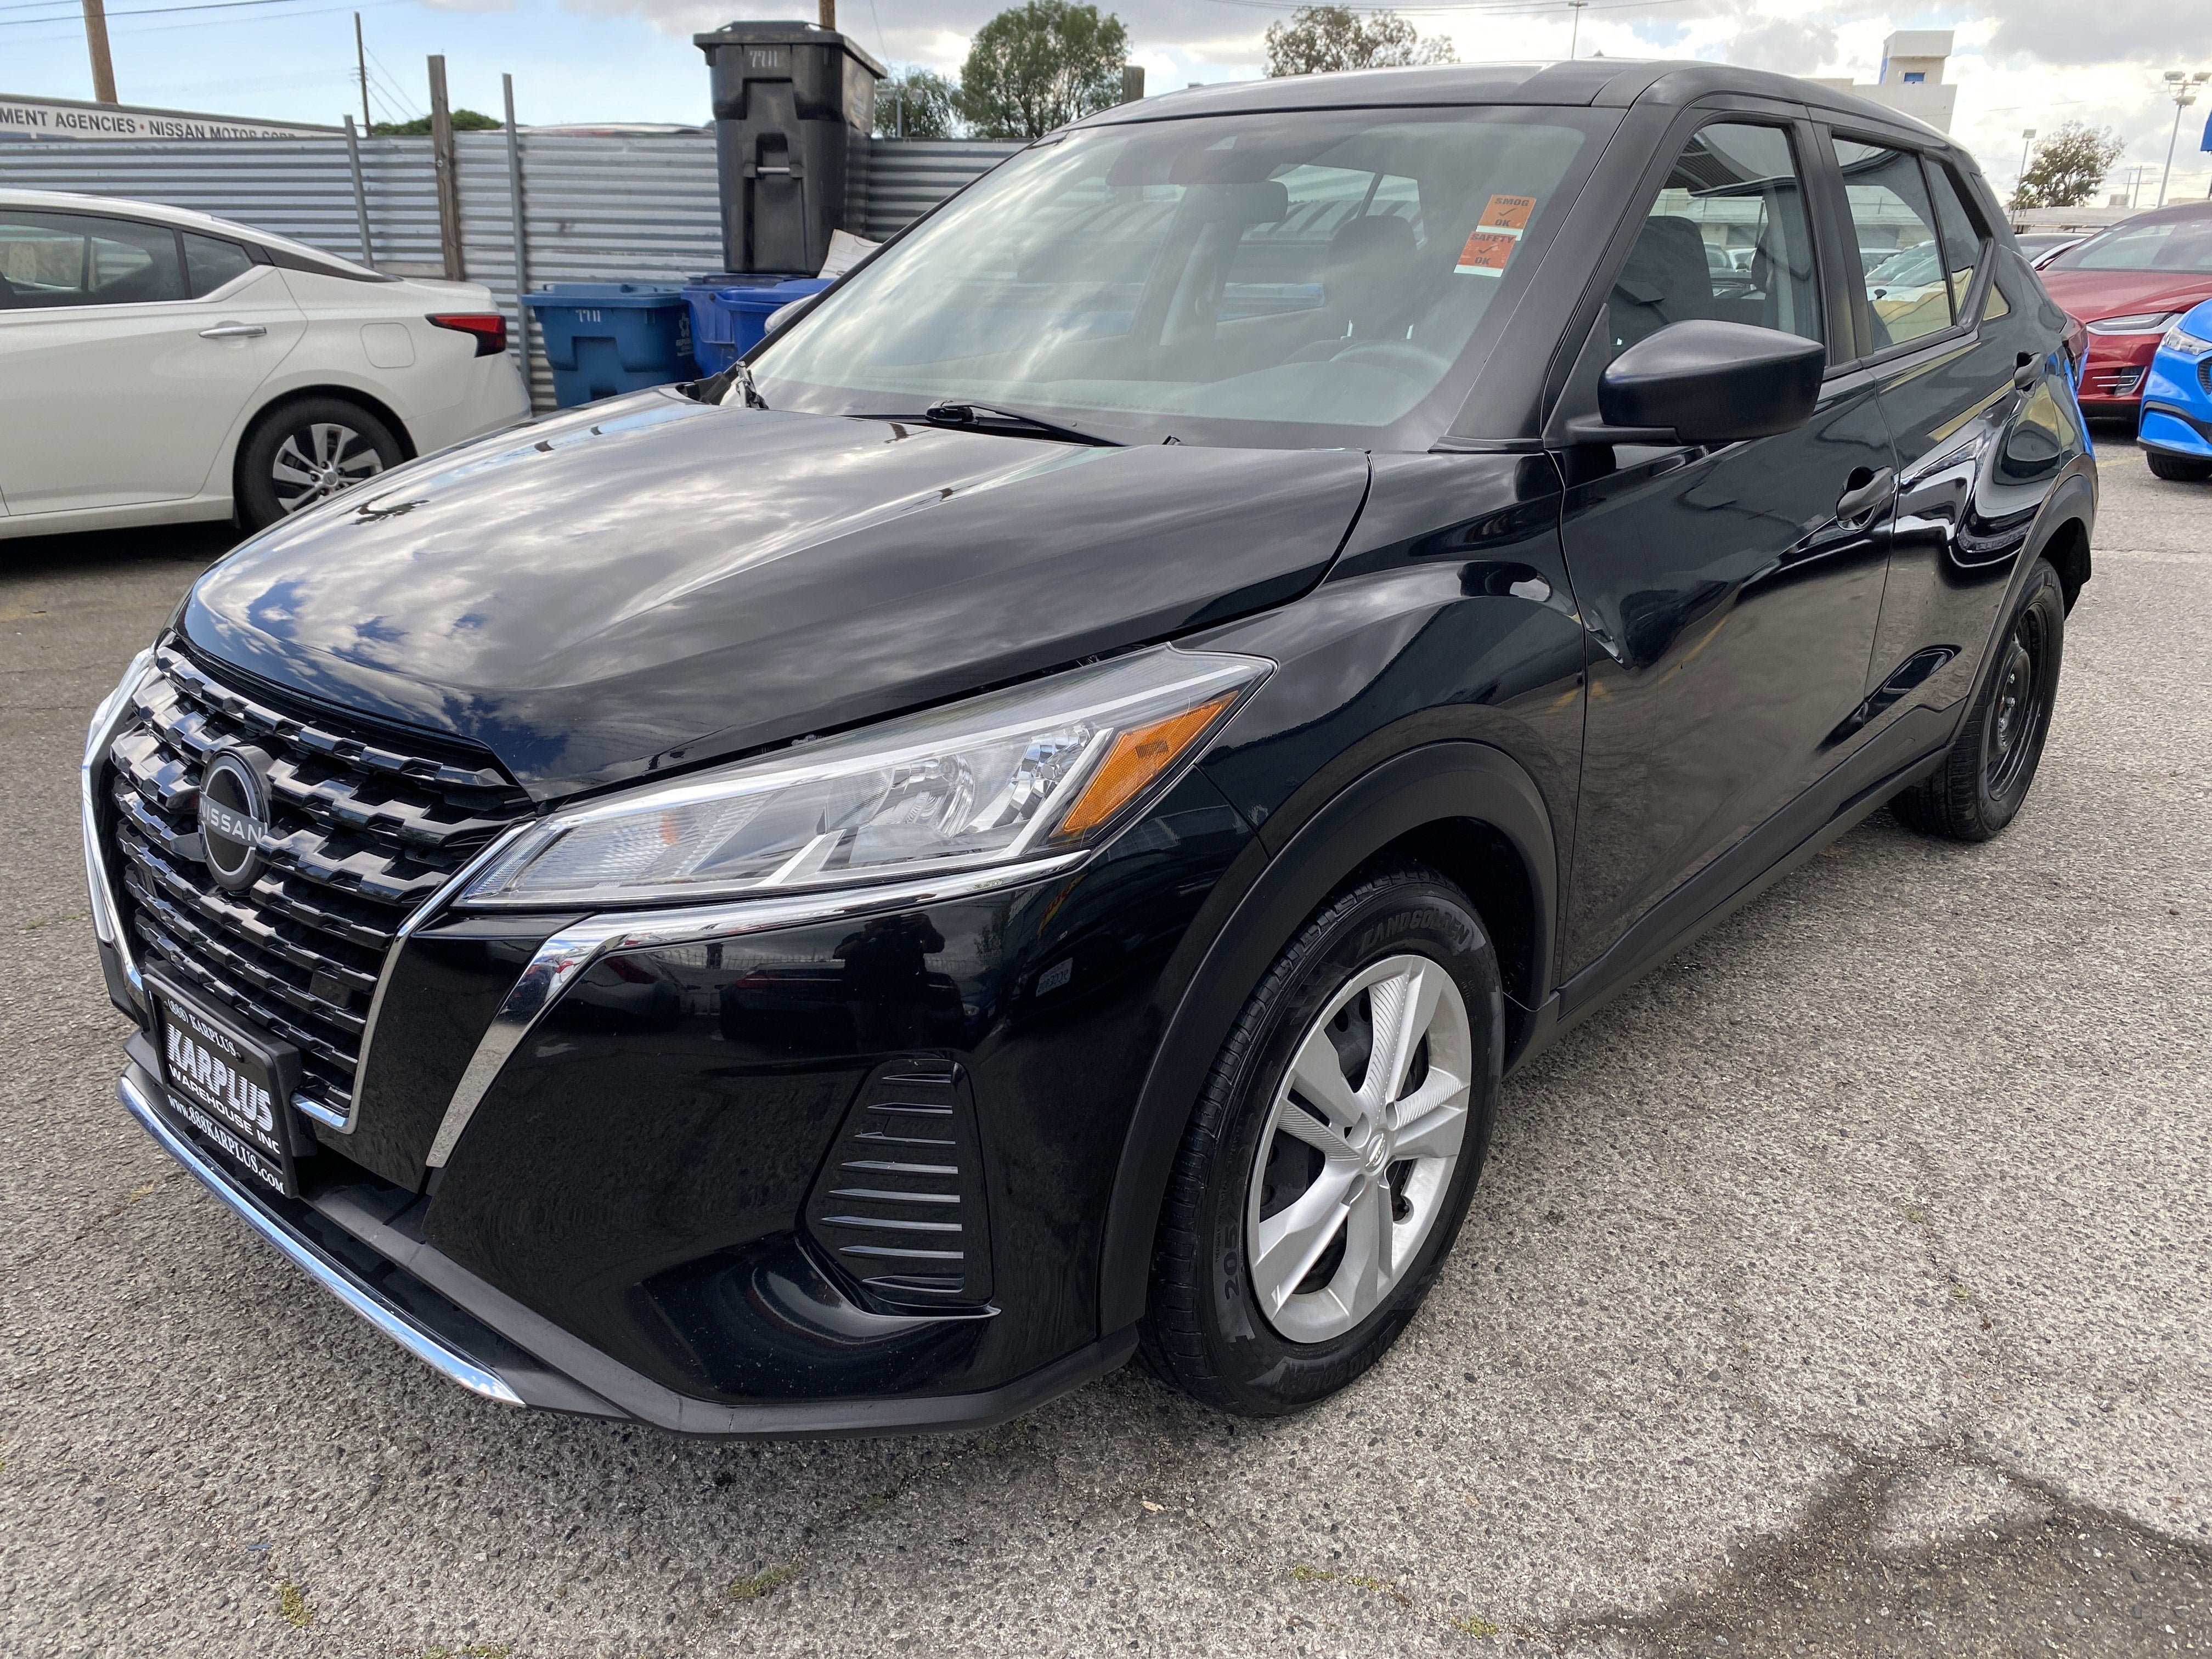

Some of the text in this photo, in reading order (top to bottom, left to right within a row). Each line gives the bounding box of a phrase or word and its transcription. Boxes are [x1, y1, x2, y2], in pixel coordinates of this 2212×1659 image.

[749, 50, 777, 67] 7711
[0, 108, 47, 126] MENT
[55, 112, 136, 133] AGENCIES
[149, 120, 205, 138] NISSAN
[1494, 198, 1530, 207] SMOG
[1471, 233, 1516, 243] SAFETY
[1474, 257, 1491, 265] OK
[575, 309, 601, 323] 7711
[199, 797, 262, 844] NISSAN
[188, 1013, 236, 1056] KARPLUS
[167, 1023, 273, 1132] KARPLUS
[169, 1063, 281, 1155] WAREHOUSE INC
